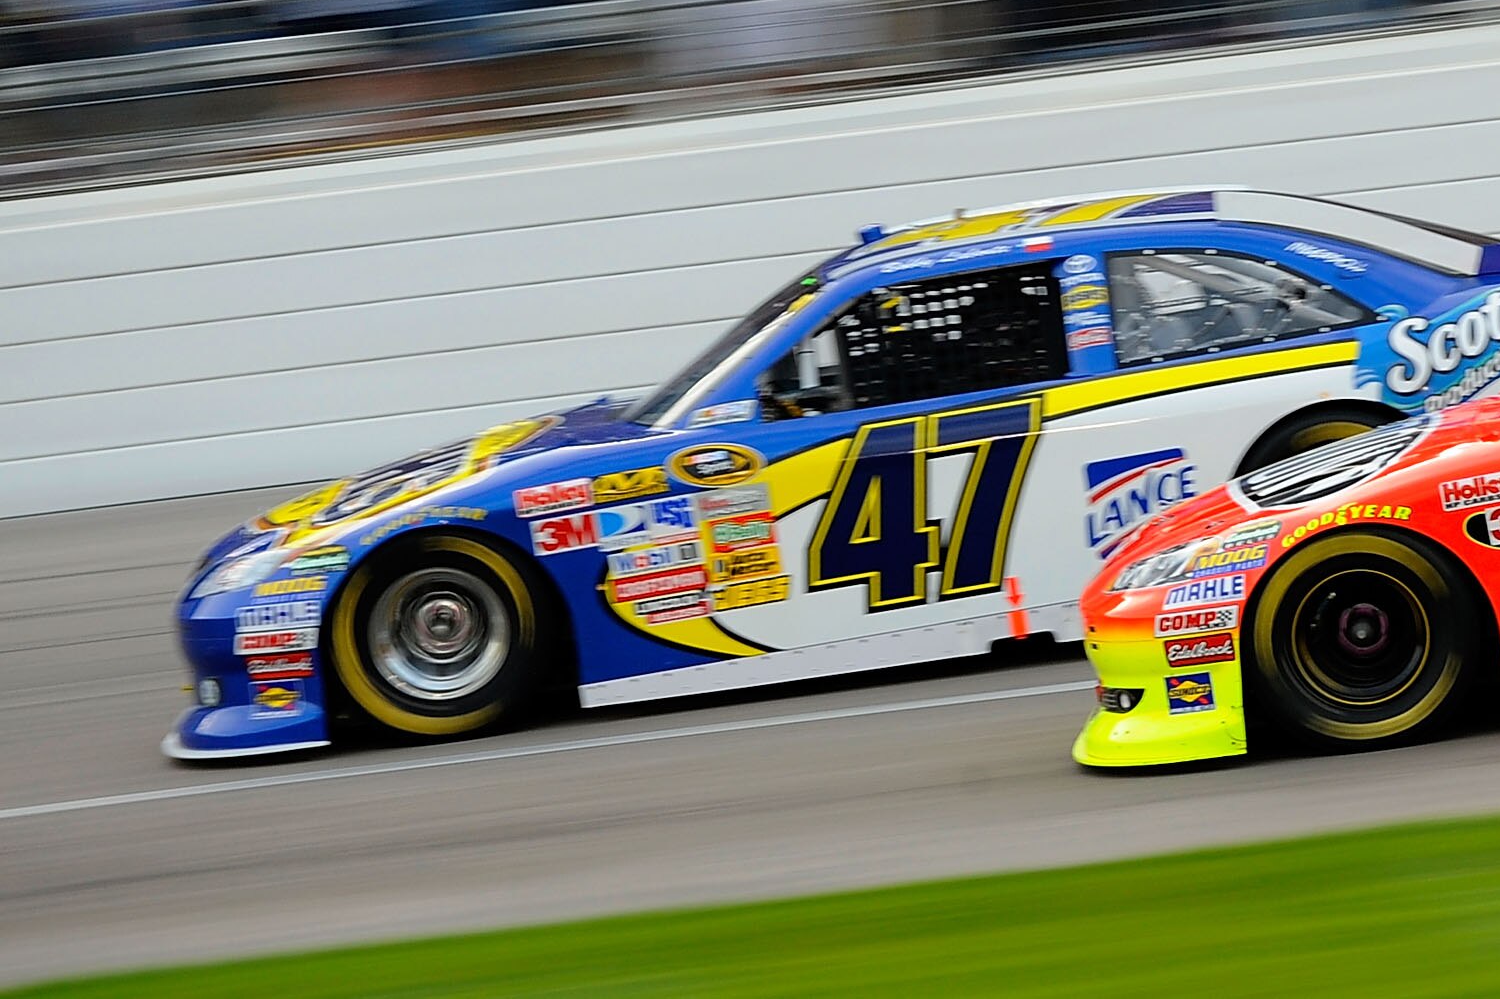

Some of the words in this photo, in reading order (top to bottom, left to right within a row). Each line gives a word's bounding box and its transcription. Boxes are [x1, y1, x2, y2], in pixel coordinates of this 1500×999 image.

[808, 397, 1043, 610] 47
[1085, 463, 1199, 548] LANCE
[539, 513, 598, 552] 3M
[1281, 504, 1413, 548] GOODYEAR
[1198, 545, 1267, 569] MOOG
[1165, 575, 1244, 606] MAHLE
[1159, 611, 1217, 633] COMP
[1167, 639, 1234, 662] Edelbrock
